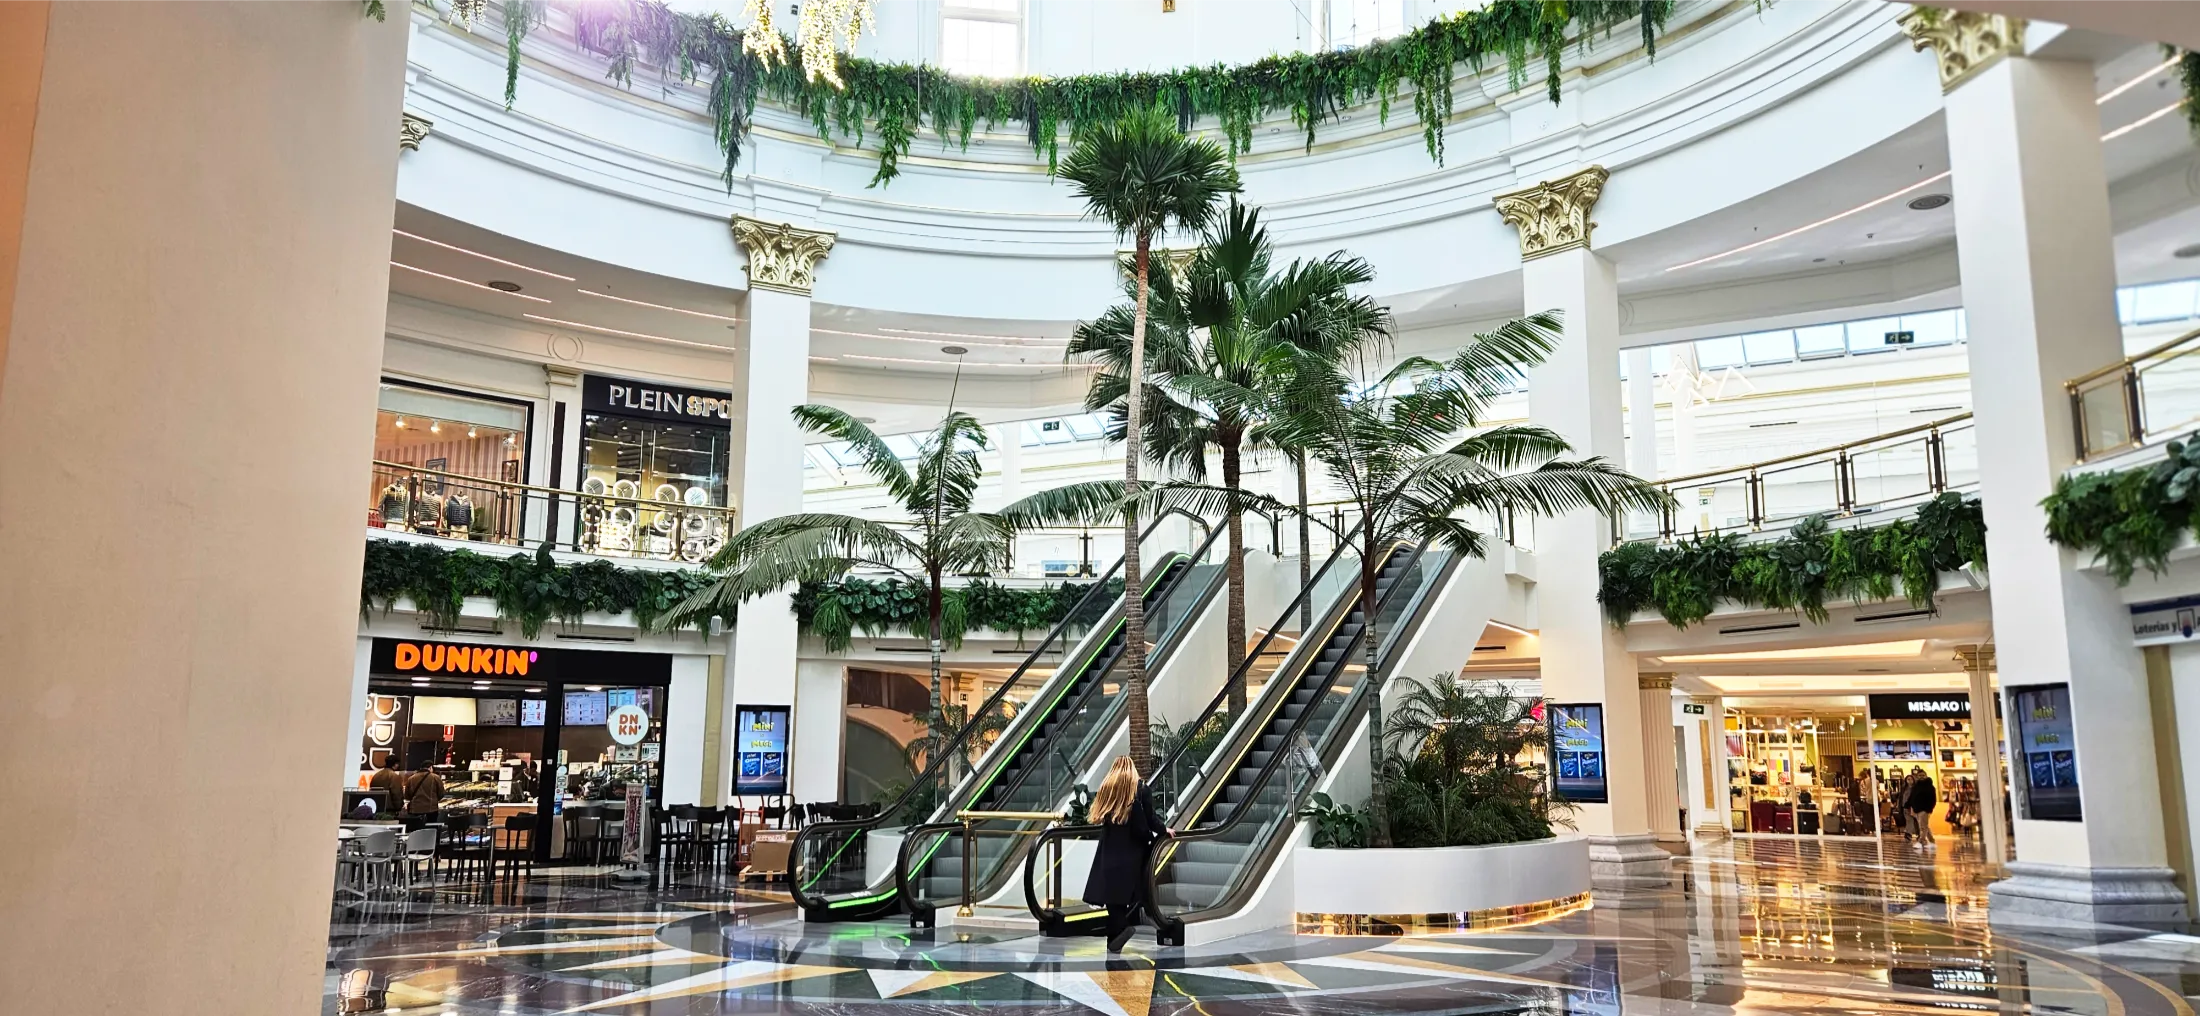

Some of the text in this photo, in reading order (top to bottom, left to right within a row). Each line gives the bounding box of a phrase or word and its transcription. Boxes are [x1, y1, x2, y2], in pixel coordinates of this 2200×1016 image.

[609, 384, 683, 414] PLEIN
[395, 642, 538, 676] DUNKIN'
[1907, 701, 1960, 712] MISAKO
[619, 714, 639, 725] DN
[618, 725, 642, 736] KN'
